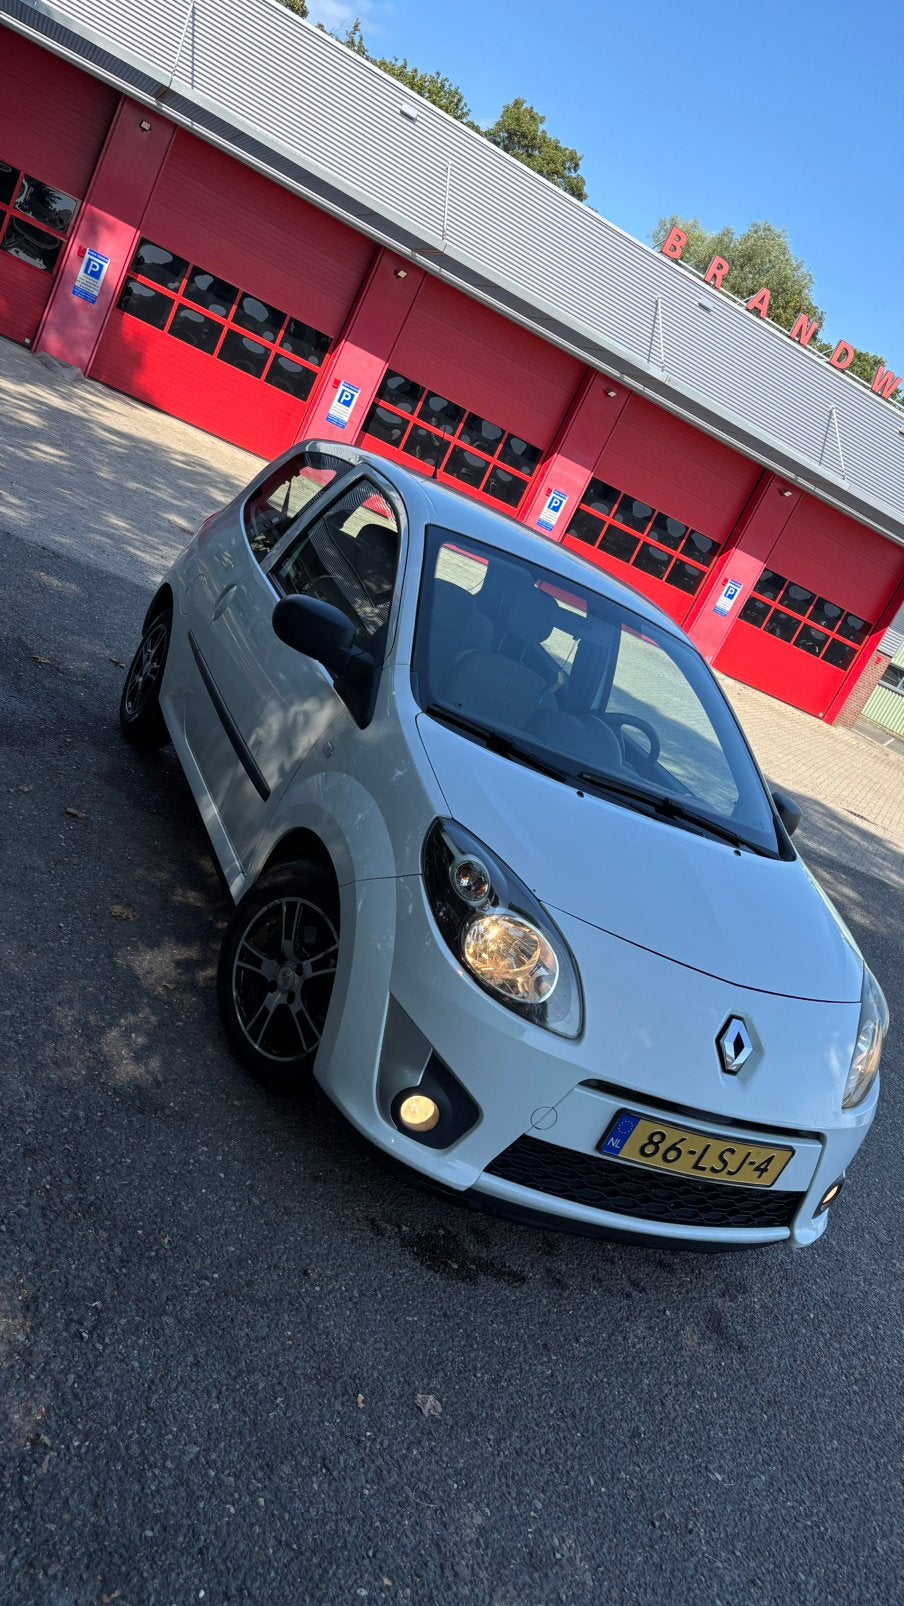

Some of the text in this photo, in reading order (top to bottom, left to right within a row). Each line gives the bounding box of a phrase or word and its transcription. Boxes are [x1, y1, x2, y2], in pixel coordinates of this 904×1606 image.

[87, 260, 100, 274] P
[340, 391, 352, 403] P
[550, 498, 560, 509] P
[725, 587, 735, 597] P
[607, 1137, 621, 1149] NL
[639, 1130, 776, 1179] 86-LSJ-4
